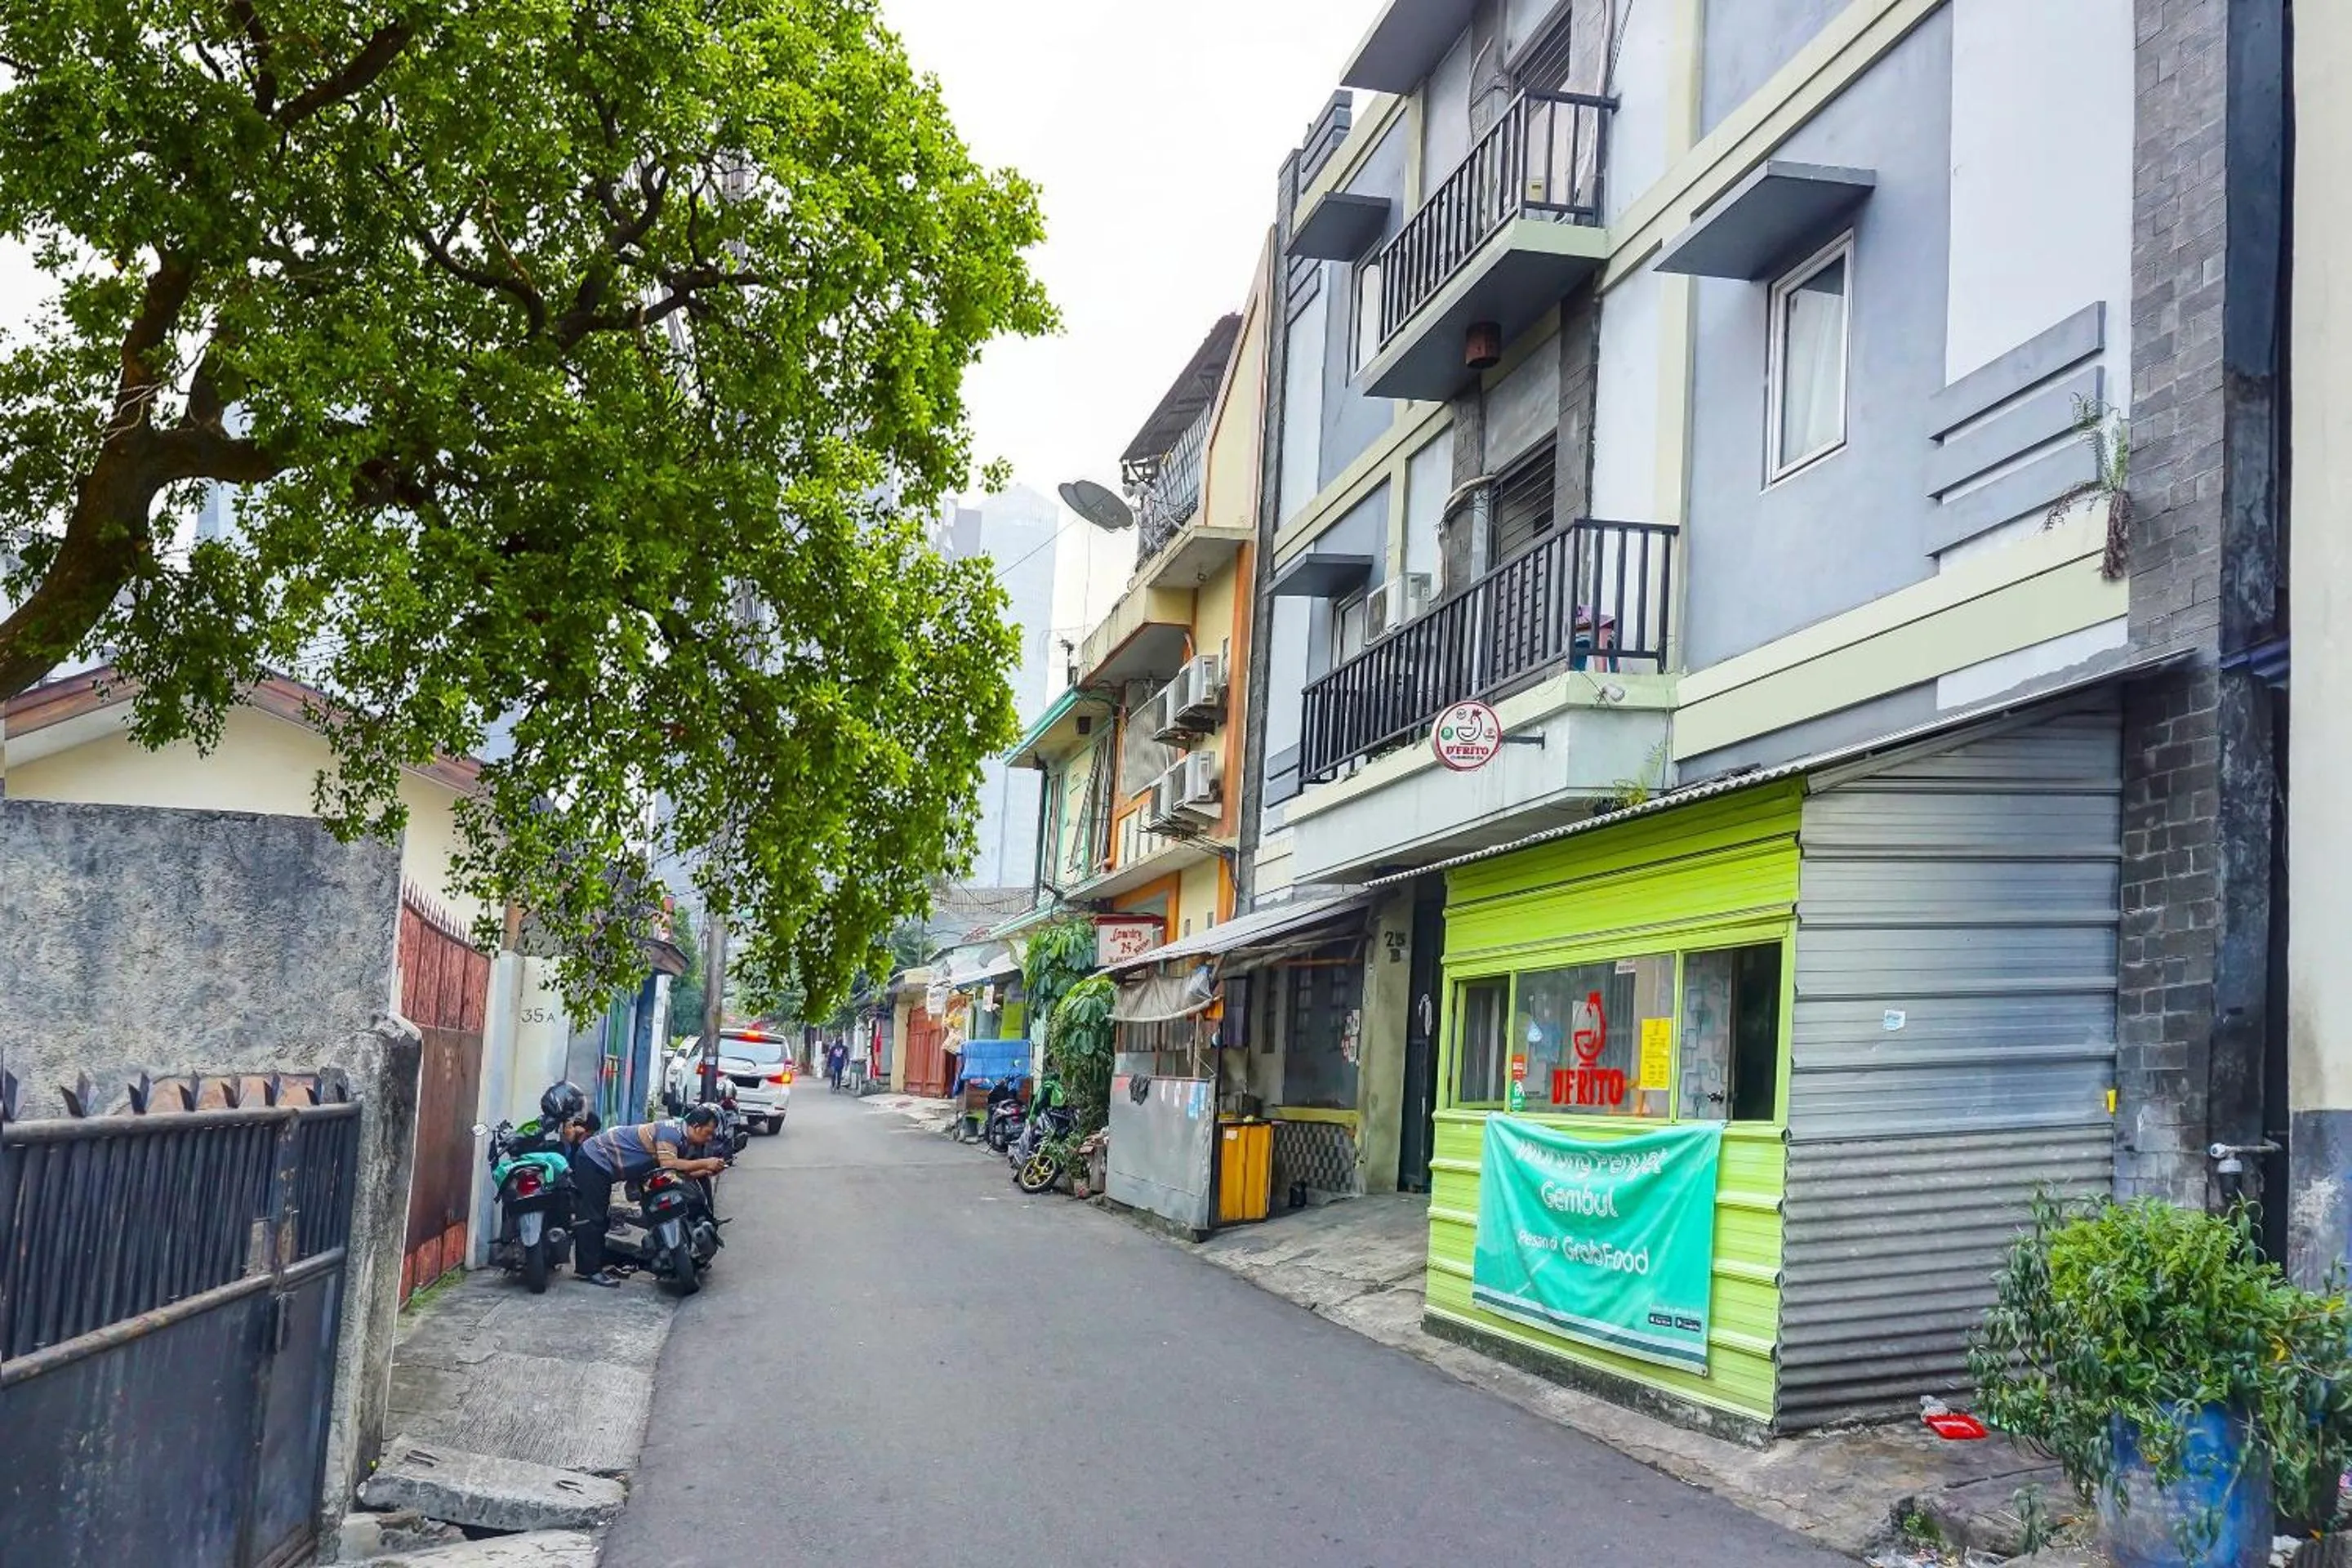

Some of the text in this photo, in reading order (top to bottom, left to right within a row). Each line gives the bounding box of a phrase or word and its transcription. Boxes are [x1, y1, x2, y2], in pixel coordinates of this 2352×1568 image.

[1446, 745, 1490, 755] D'FRITO
[1540, 1180, 1619, 1218] Gembul
[1561, 1235, 1650, 1276] GrabFood
